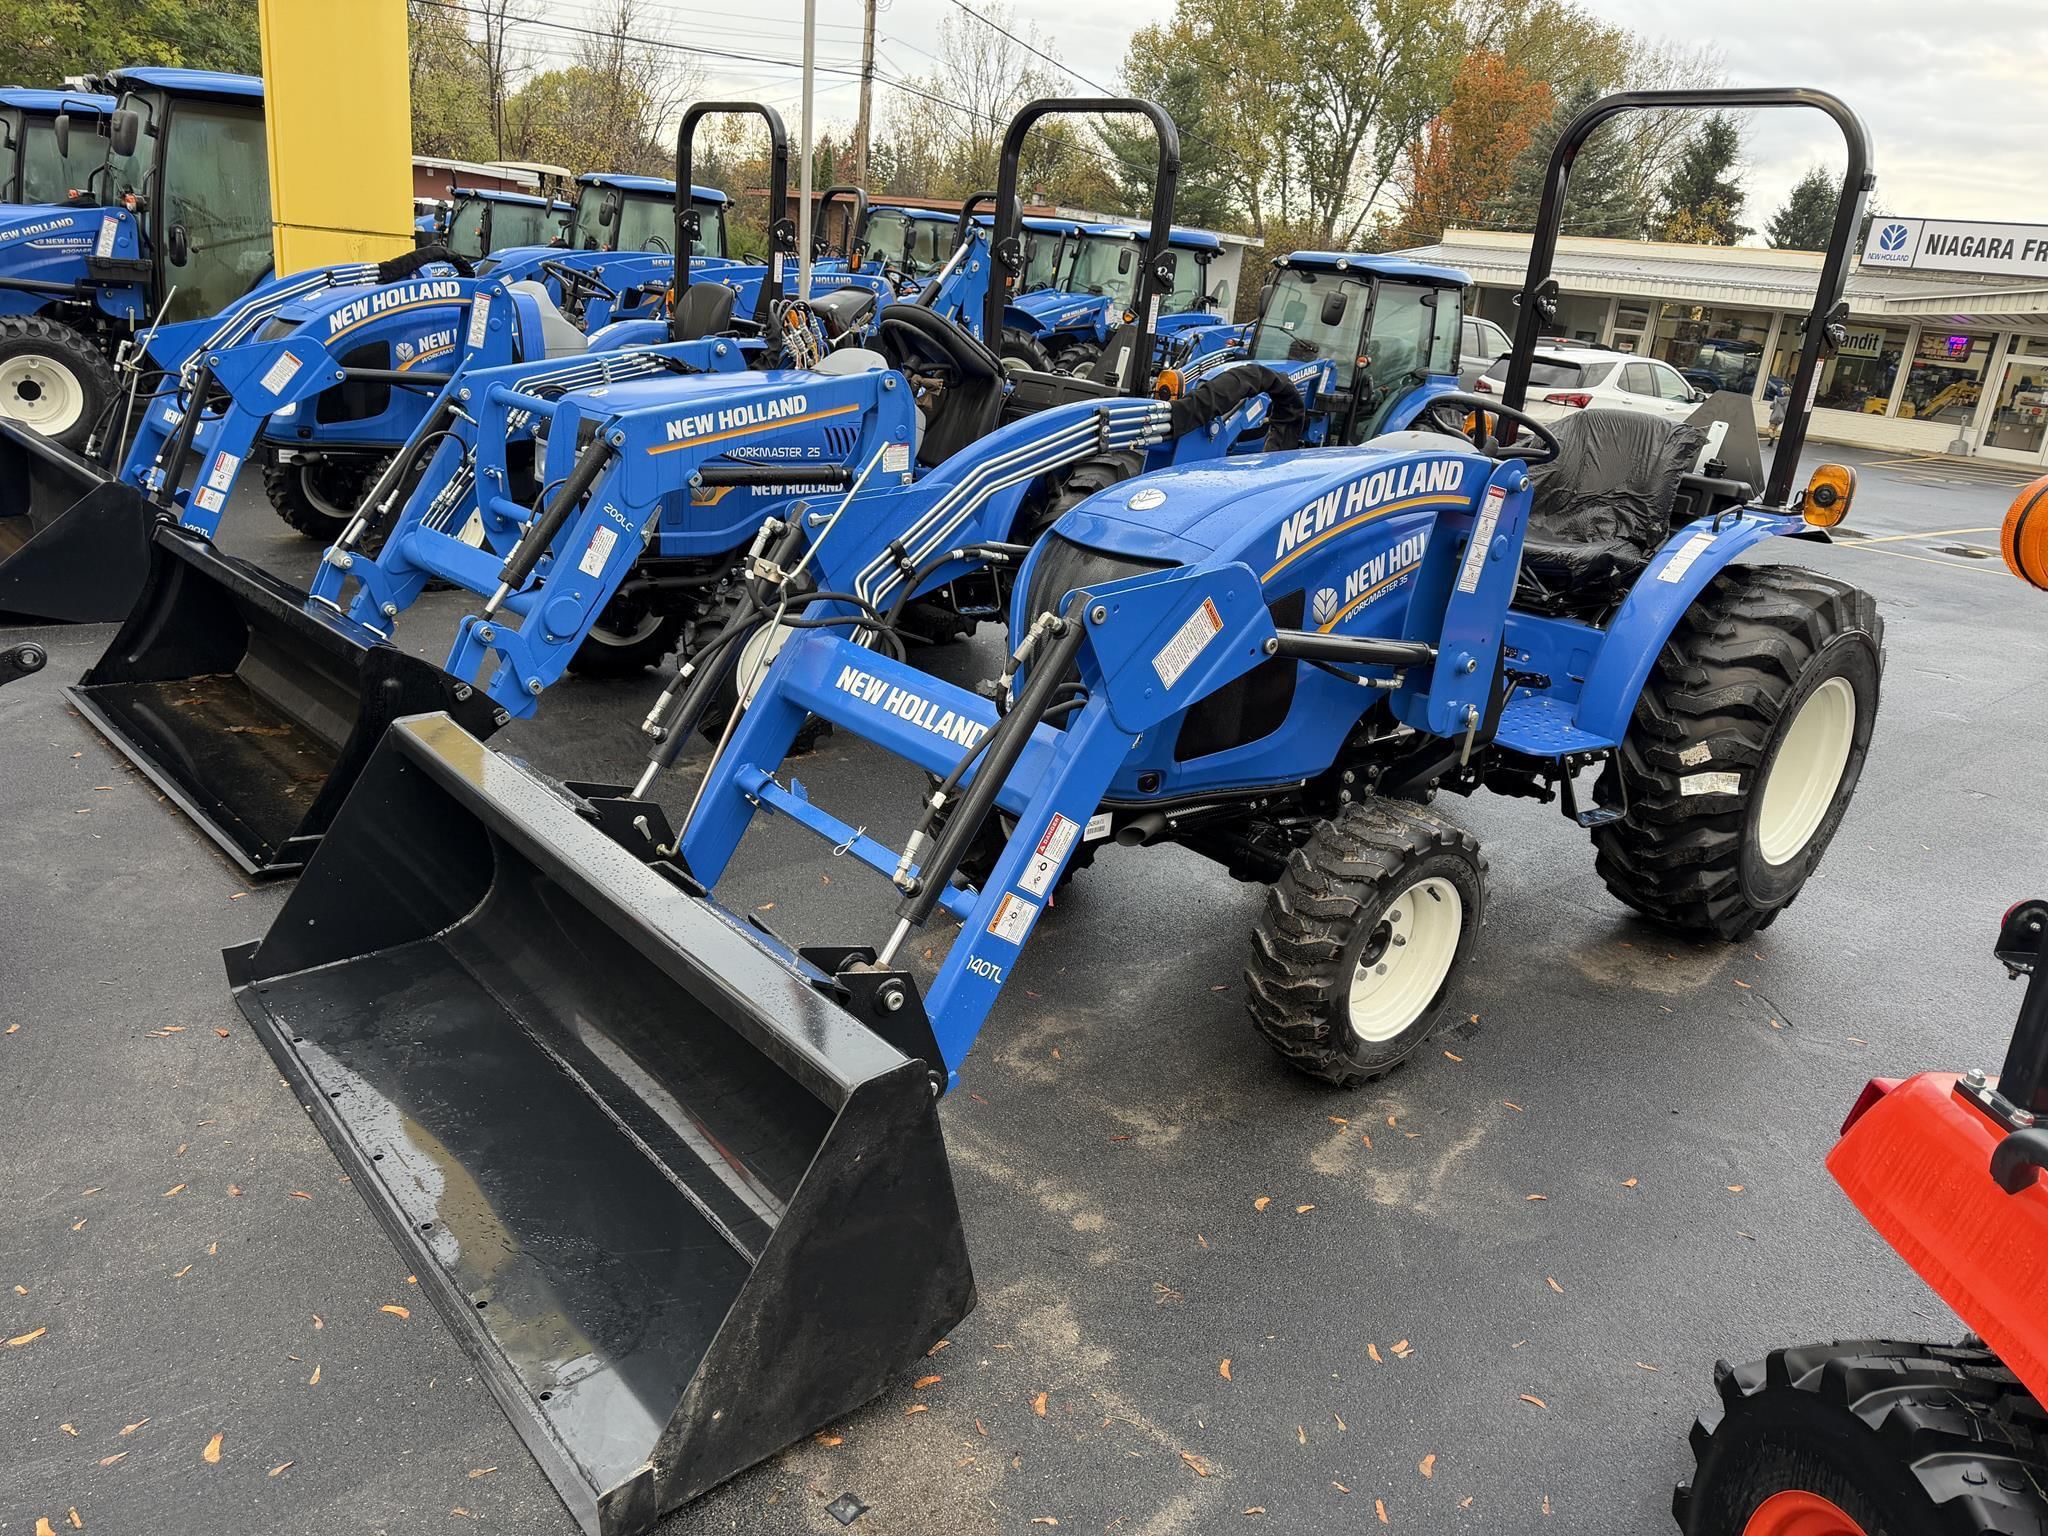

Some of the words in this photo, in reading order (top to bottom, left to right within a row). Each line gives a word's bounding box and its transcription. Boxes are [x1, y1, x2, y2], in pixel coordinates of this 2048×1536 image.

[0, 229, 19, 241] EW
[21, 217, 74, 236] HOLLAND
[1867, 252, 1881, 260] NEW
[1881, 253, 1909, 262] HOLLAND
[1925, 233, 2014, 260] NIAGARA
[815, 276, 852, 284] HOLLAND
[329, 298, 369, 334] NEW
[372, 281, 461, 313] HOLLAND
[419, 329, 450, 353] NEW
[1840, 333, 1879, 350] andit
[666, 414, 714, 441] NEW
[718, 394, 808, 430] HOLLAND
[807, 447, 820, 457] 25
[751, 483, 783, 496] NEW
[786, 482, 843, 494] HOLLAND
[603, 502, 635, 532] 200LC
[1275, 486, 1344, 560] NEW
[1344, 460, 1464, 518] HOLLAND
[1345, 551, 1386, 603] NEW
[1344, 580, 1399, 623] WORKMASTER
[1398, 574, 1408, 586] 35
[835, 665, 889, 705] NEW
[883, 687, 989, 750] HOLLAND
[966, 954, 1002, 984] 140TL
